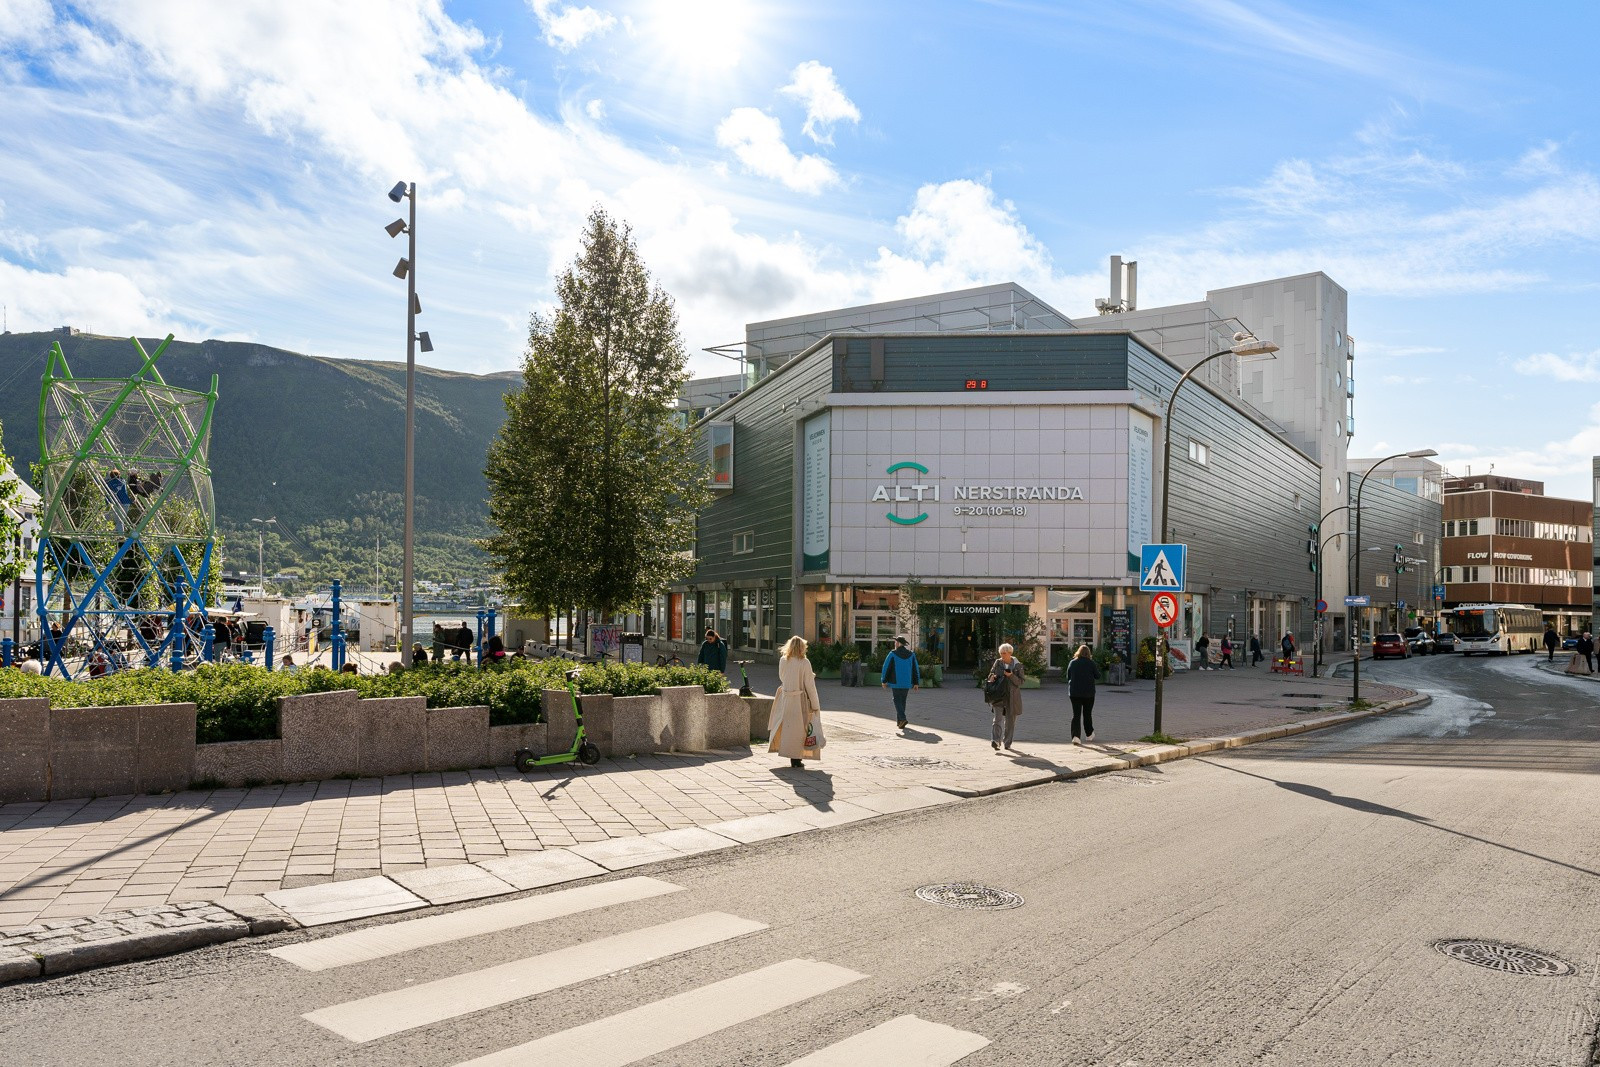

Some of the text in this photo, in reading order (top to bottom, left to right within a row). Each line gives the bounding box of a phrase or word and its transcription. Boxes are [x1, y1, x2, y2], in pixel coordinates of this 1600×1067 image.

[966, 380, 987, 389] 29 8
[871, 484, 940, 502] ALTI
[953, 485, 1084, 501] NERSTRANDA
[948, 606, 1000, 614] VELKOMMEN
